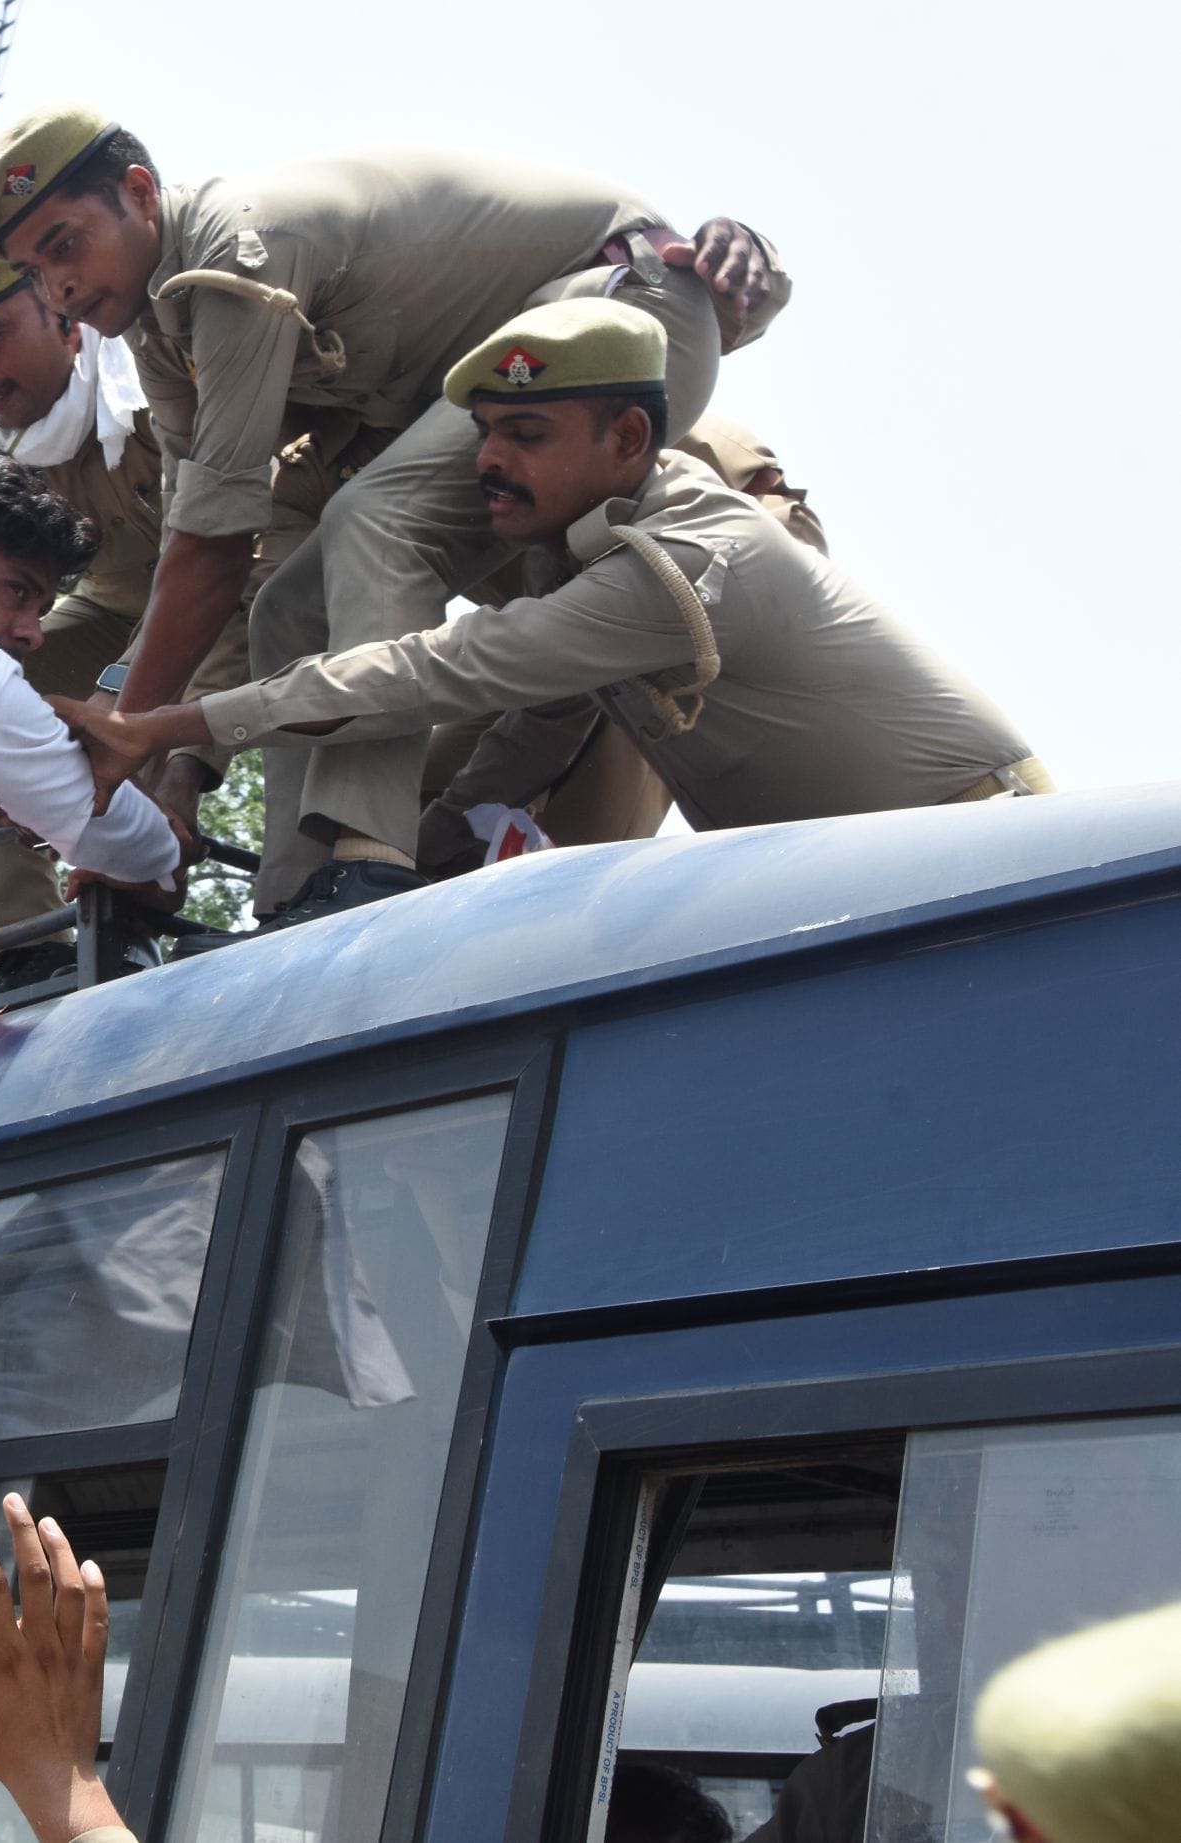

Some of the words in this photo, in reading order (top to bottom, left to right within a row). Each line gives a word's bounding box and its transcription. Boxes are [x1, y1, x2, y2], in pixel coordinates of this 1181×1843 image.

[635, 1544, 643, 1560] OF
[630, 1561, 641, 1589] BPSL
[613, 1691, 620, 1699] A
[606, 1701, 619, 1756] PRODUCT
[602, 1758, 611, 1774] OF
[598, 1775, 609, 1805] BPSL
